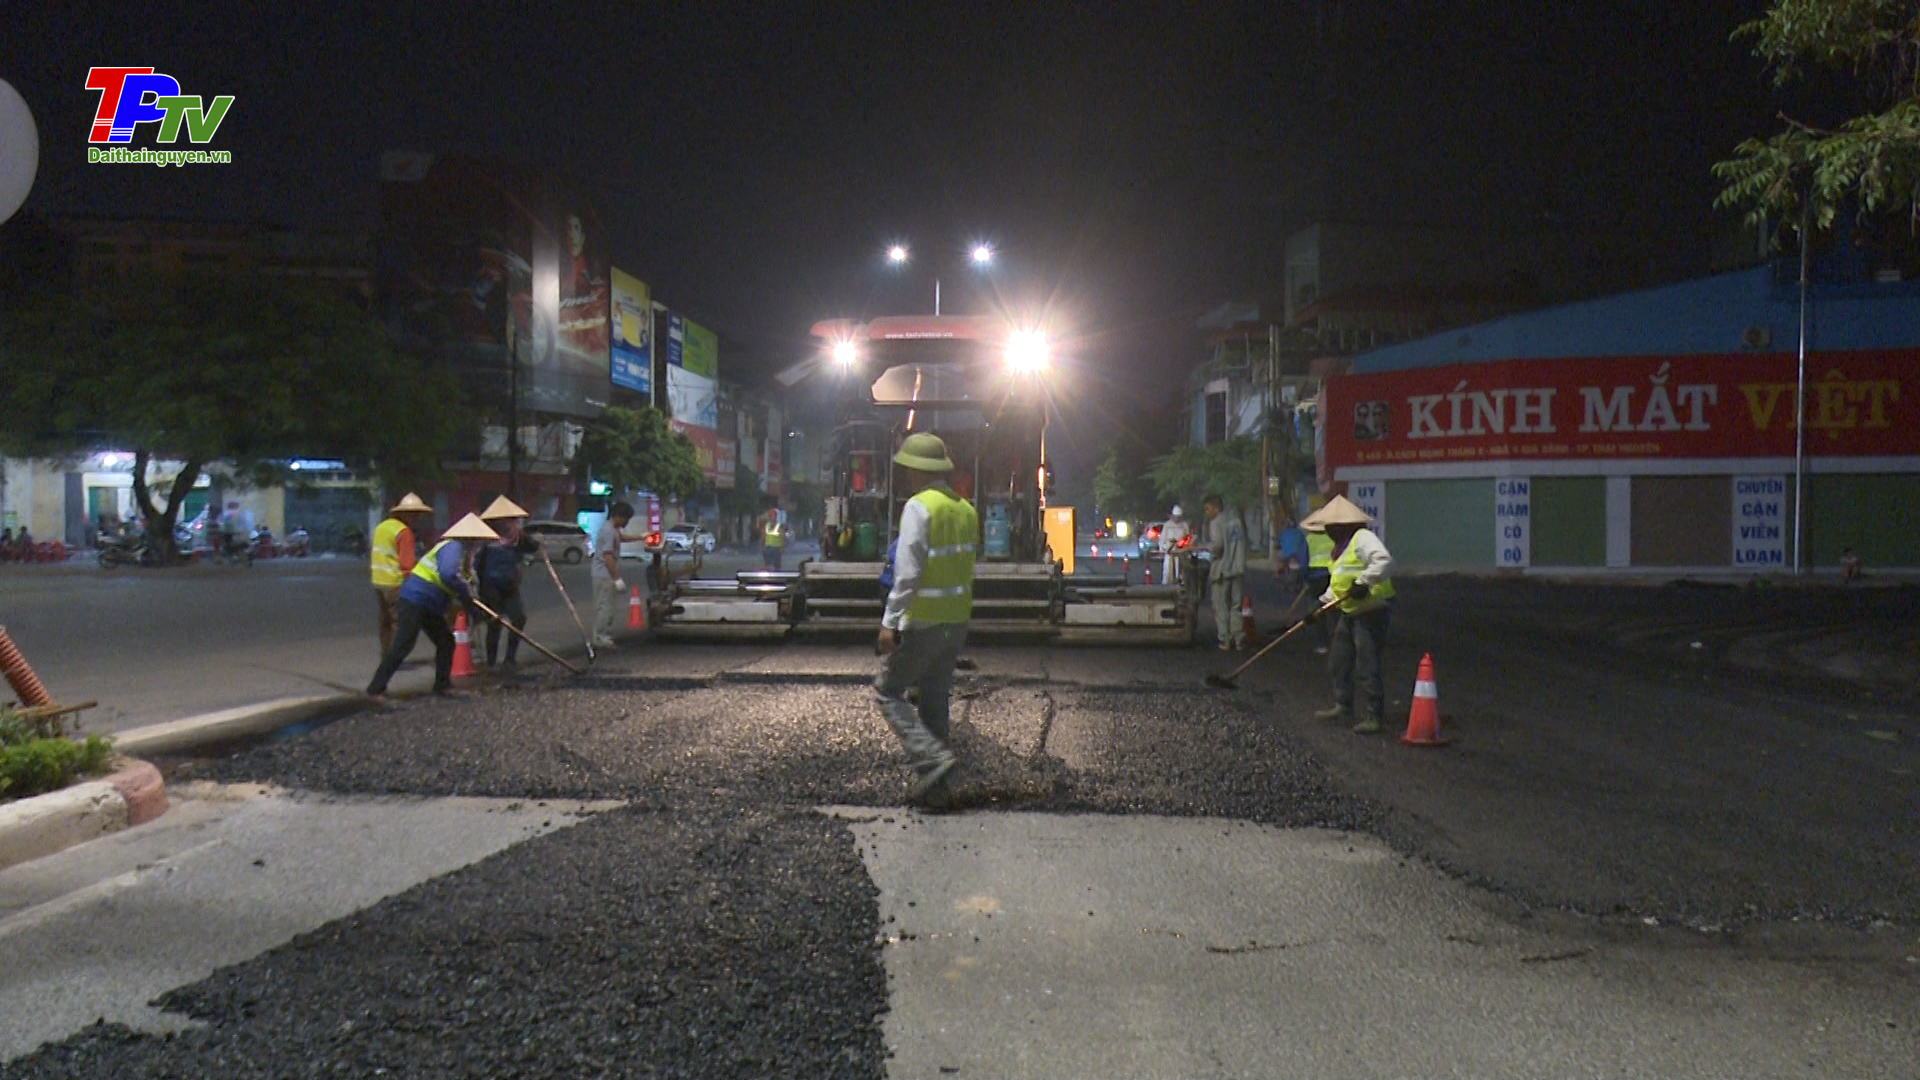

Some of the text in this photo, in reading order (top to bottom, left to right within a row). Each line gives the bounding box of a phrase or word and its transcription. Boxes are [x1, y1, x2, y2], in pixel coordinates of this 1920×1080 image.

[1407, 362, 1900, 439] KÍNH MẮT VIỆT
[1357, 486, 1376, 498] UY
[1360, 502, 1378, 518] ÍN
[1736, 548, 1782, 565] LOẠN
